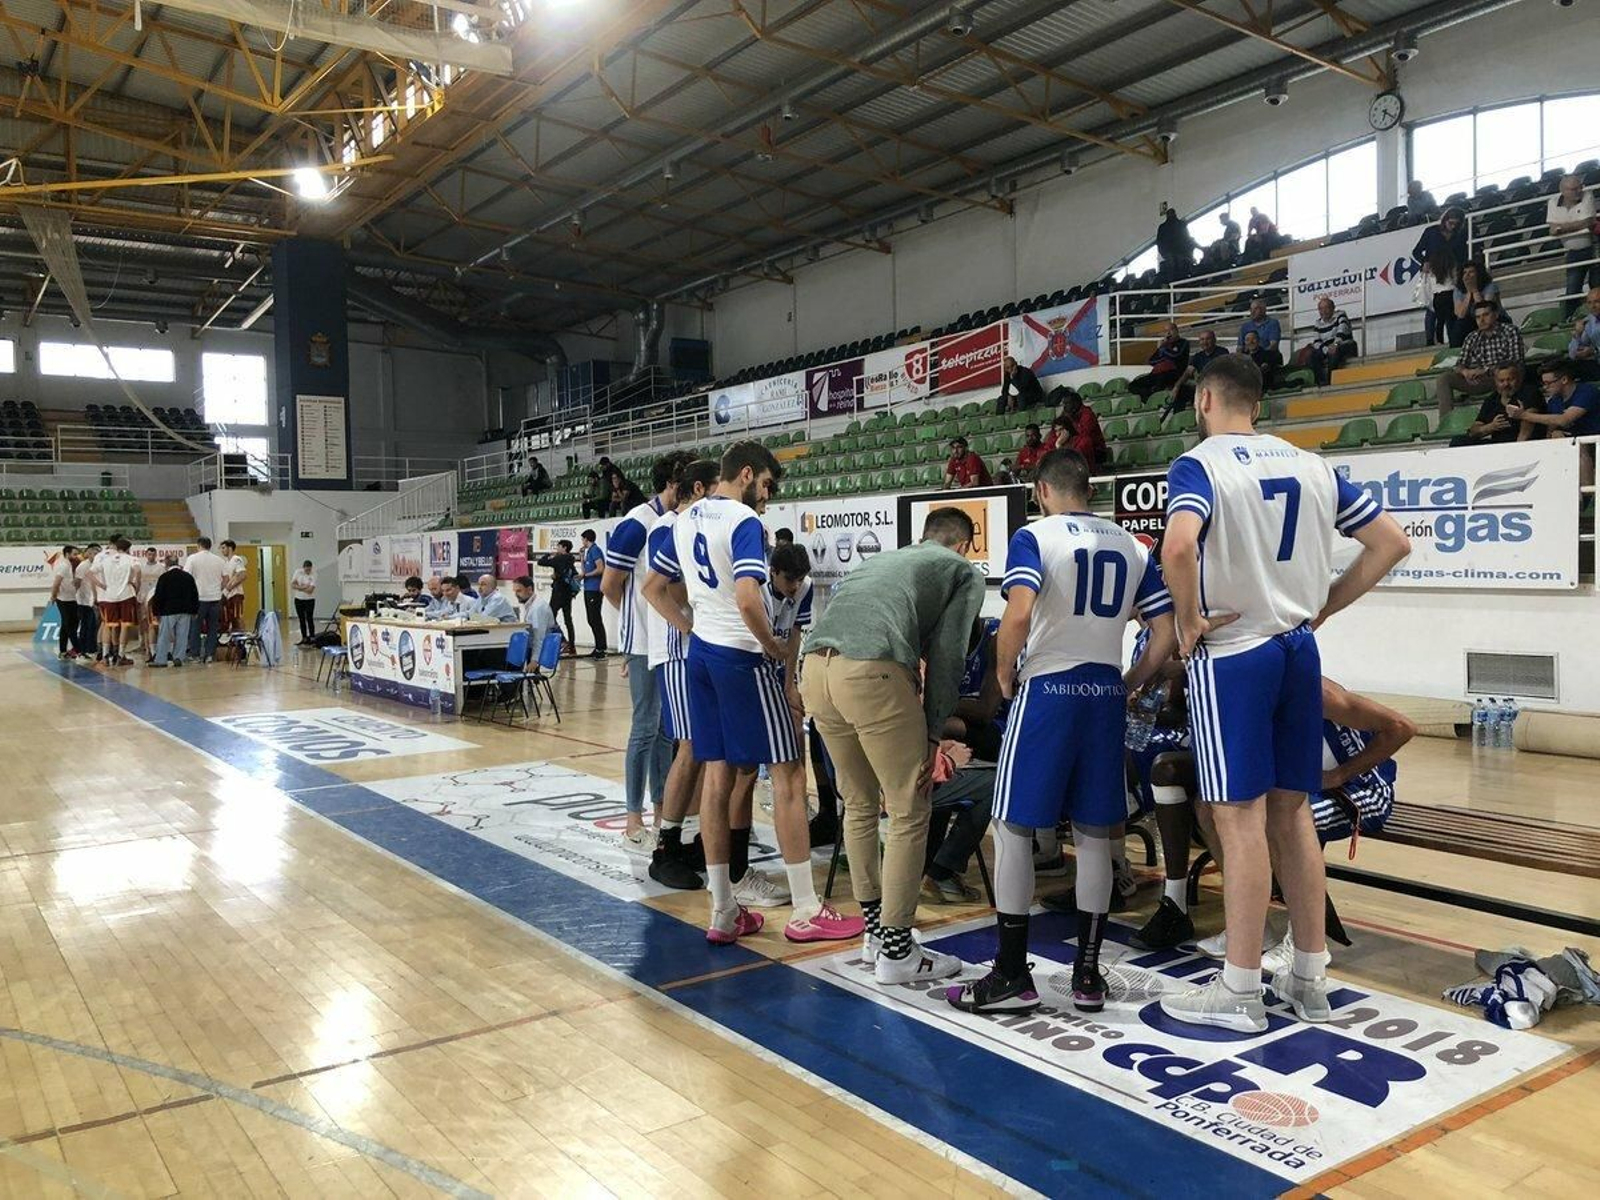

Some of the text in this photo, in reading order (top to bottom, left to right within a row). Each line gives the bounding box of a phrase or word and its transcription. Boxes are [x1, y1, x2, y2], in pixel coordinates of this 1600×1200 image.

[1312, 286, 1363, 301] PONFERRAD
[869, 370, 899, 385] esRaio
[912, 353, 923, 379] 8
[828, 386, 856, 401] hospita
[815, 510, 894, 529] LEOMOTOR, S.L.
[1258, 476, 1302, 562] 7
[1403, 519, 1433, 538] ción
[1434, 511, 1533, 554] gas
[693, 531, 719, 589] 9
[1387, 567, 1562, 581] ragas-clima.com
[1073, 547, 1128, 619] 10
[221, 714, 391, 761] COSMOS
[1328, 1008, 1500, 1066] 2018
[1154, 1101, 1306, 1170] Ponferrada
[1175, 1095, 1323, 1161] C.B. Ciudad de
